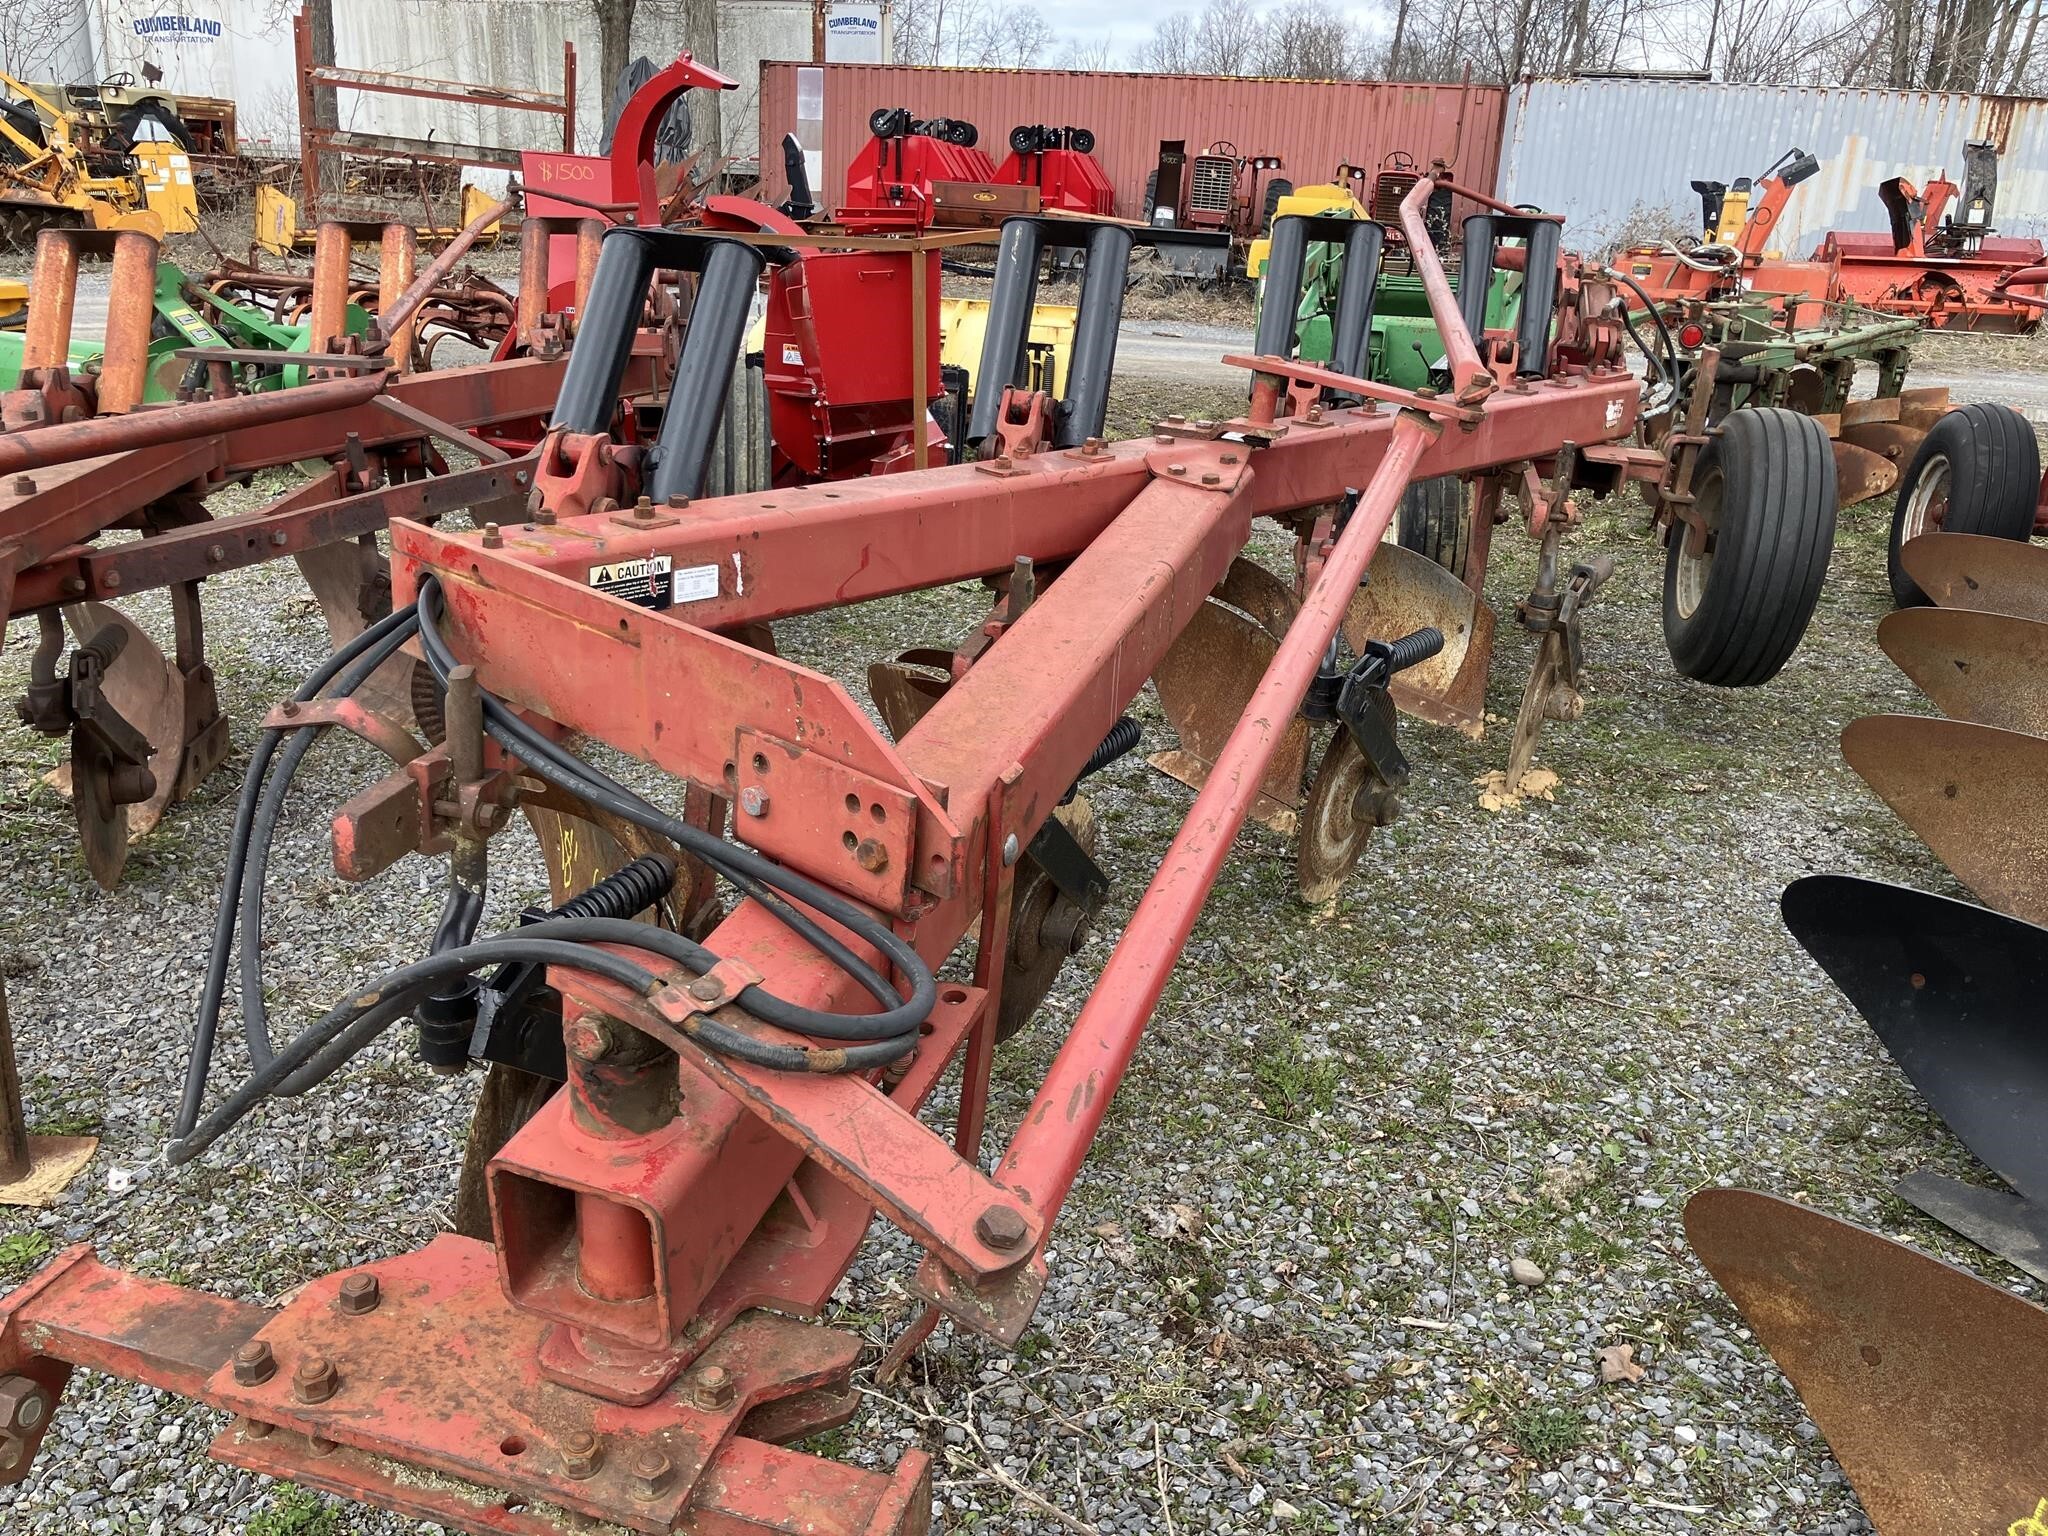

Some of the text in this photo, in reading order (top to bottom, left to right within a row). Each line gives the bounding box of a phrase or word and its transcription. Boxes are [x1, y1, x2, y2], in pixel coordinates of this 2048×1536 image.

[133, 16, 221, 37] CUMBERLAND
[829, 16, 878, 29] CUMBERLAND
[144, 35, 213, 44] TRANSPORTATION
[538, 160, 594, 183] $1500
[617, 560, 664, 580] CAUTION
